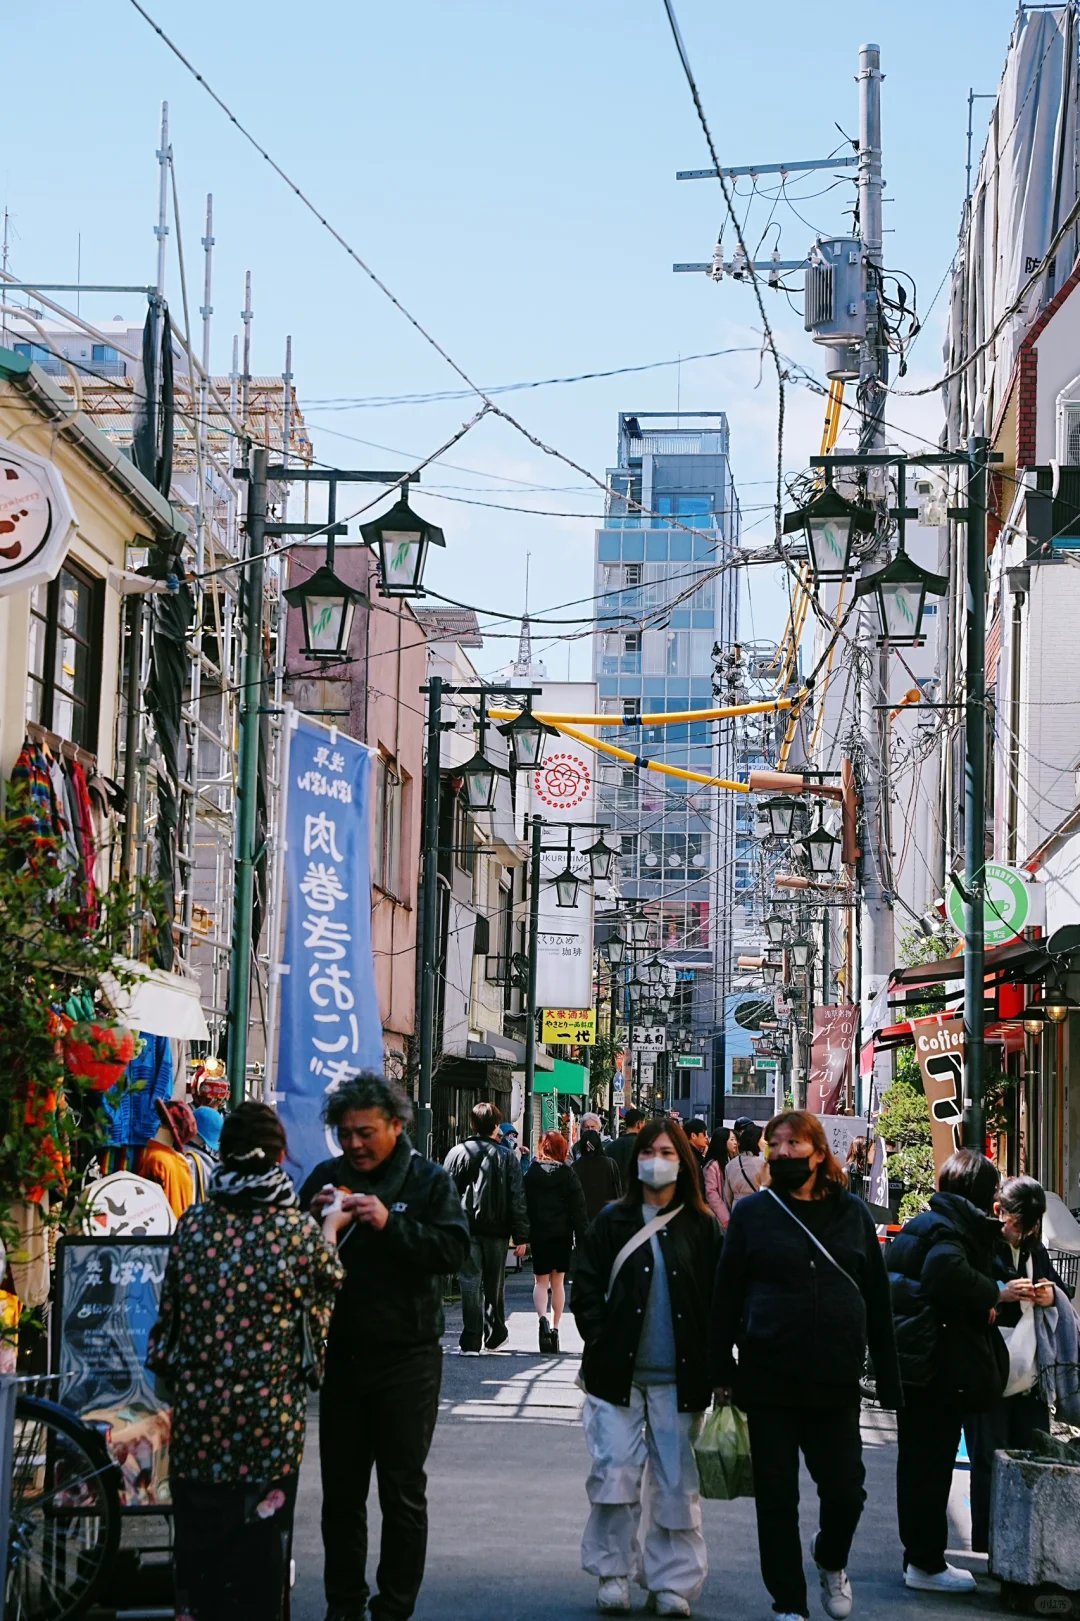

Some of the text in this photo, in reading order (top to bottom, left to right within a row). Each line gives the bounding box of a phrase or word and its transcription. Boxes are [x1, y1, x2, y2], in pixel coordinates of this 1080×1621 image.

[562, 947, 583, 957] 珈琲
[545, 1009, 589, 1020] 大衆酒場
[824, 1009, 852, 1019] 浅草名物
[557, 1029, 591, 1043] 一代
[918, 1029, 965, 1052] Coffee
[819, 1022, 837, 1115] チーズカレー
